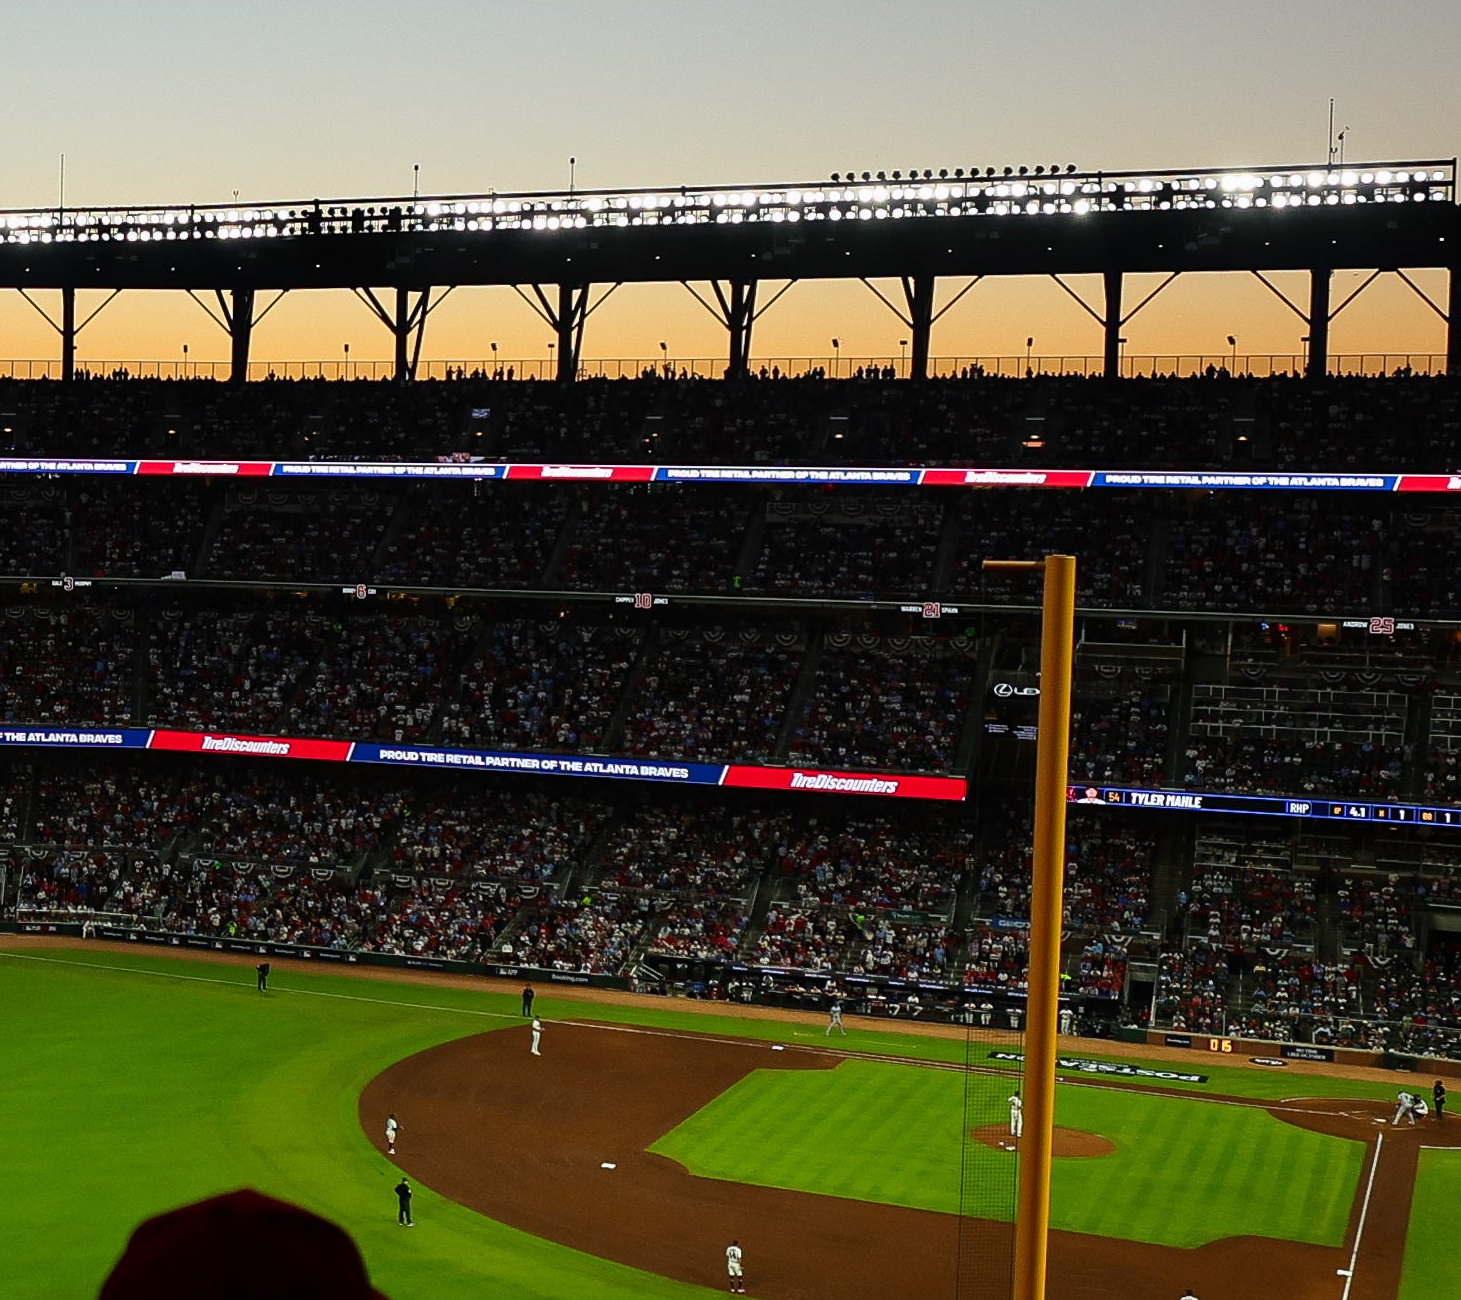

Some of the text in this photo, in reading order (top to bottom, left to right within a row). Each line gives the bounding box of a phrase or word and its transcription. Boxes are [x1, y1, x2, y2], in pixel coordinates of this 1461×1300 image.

[635, 593, 653, 610] 10
[923, 602, 941, 618] 21
[1369, 617, 1394, 634] 25
[4, 732, 26, 743] THE
[27, 733, 77, 743] ATLANTA
[78, 733, 123, 744] BRAVES
[201, 735, 290, 756] TireDiscounters
[378, 748, 689, 780] PROUD TIRE RETAIL PARTNER OF THE ATLANTA BRAVES
[790, 771, 897, 795] TireDiscounters
[1131, 793, 1366, 818] TYLER MAHLE RHP 4.1
